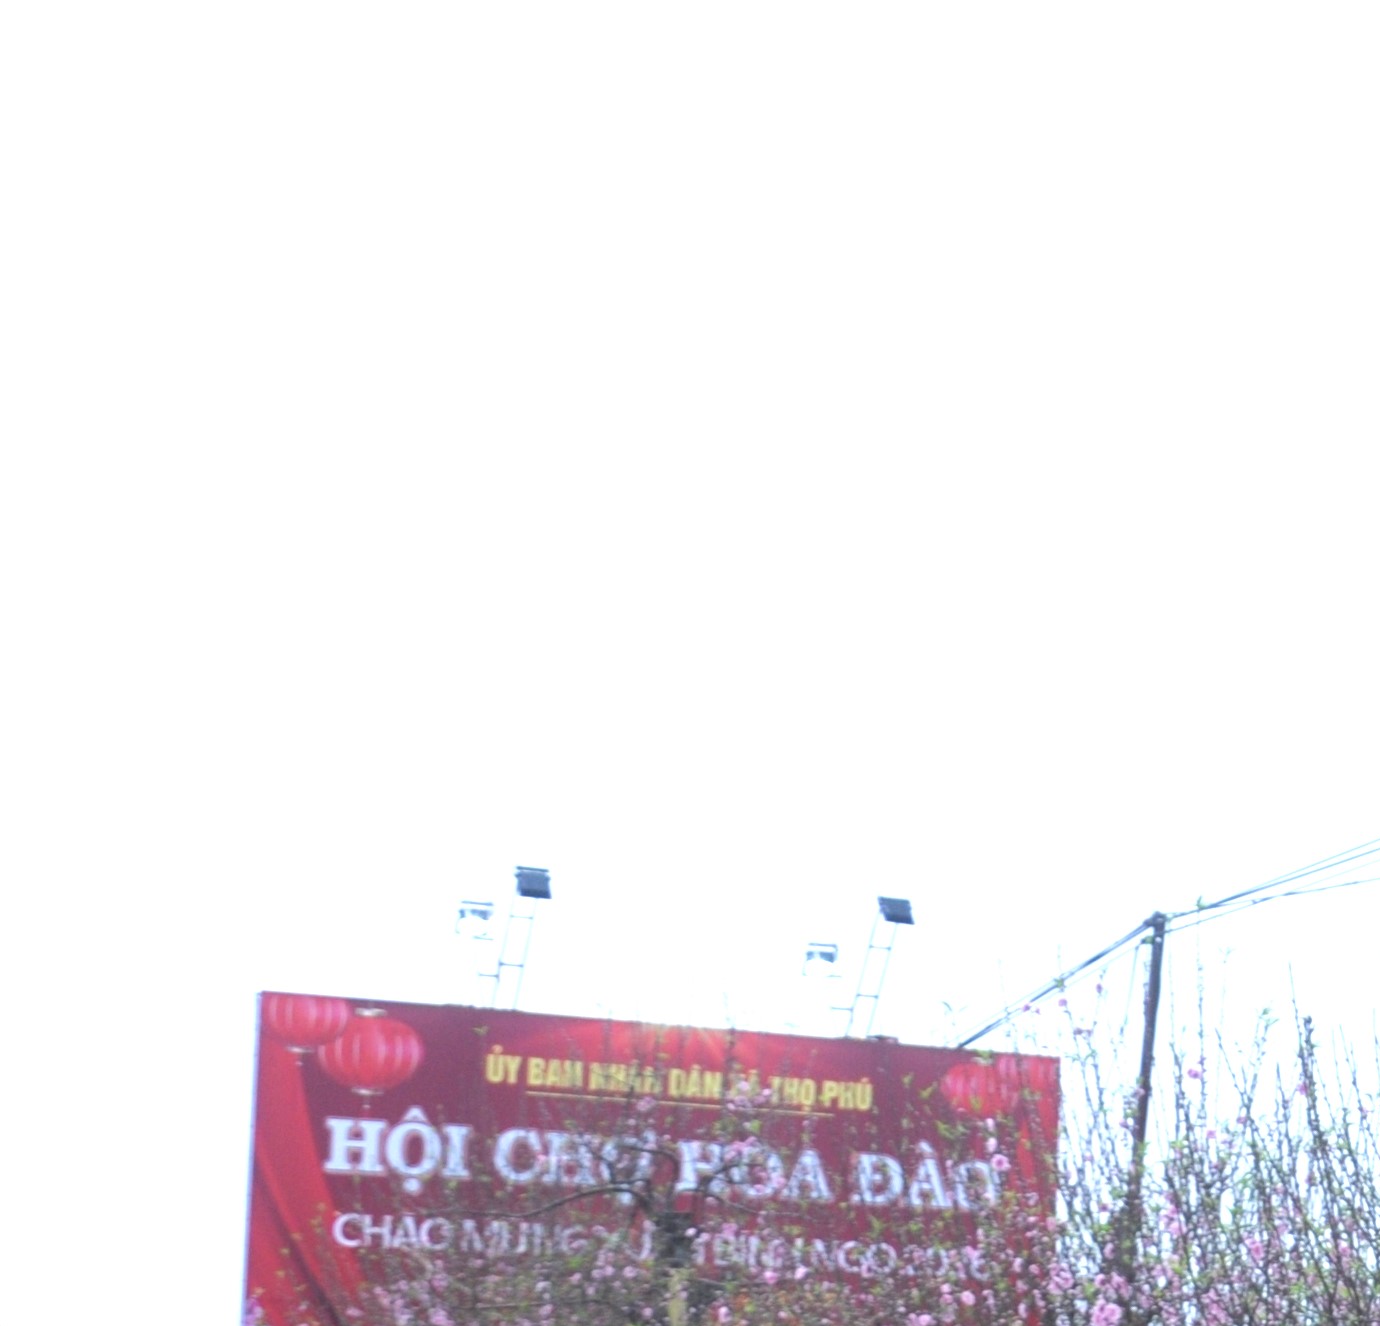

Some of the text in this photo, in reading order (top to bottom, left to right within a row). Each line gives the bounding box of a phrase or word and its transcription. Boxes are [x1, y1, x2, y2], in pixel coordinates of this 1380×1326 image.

[486, 1044, 523, 1085] ỦY
[527, 1056, 583, 1089] BAN
[668, 1064, 723, 1099] DÂN
[822, 1076, 873, 1111] PHÚ
[323, 1105, 473, 1195] HỘI
[674, 1139, 832, 1200] HOA
[851, 1139, 1002, 1209] ĐÀO
